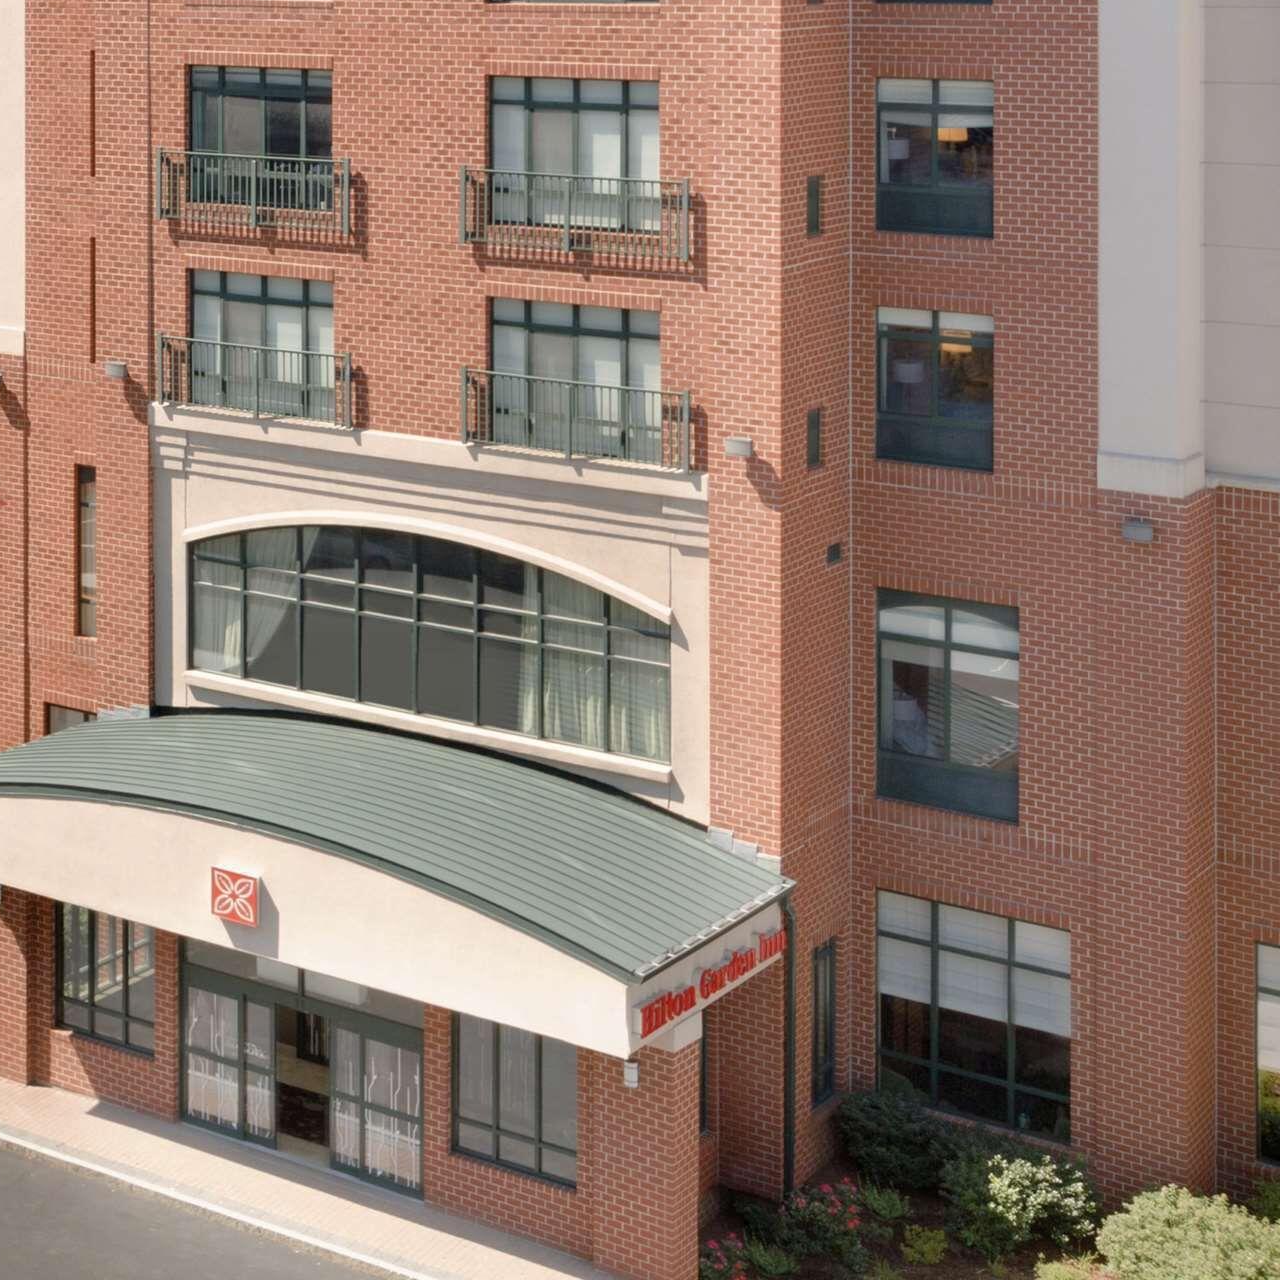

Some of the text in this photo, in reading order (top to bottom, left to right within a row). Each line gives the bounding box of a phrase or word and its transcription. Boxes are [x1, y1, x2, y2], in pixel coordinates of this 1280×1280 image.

[641, 928, 788, 1040] Hilton Garden Inn
